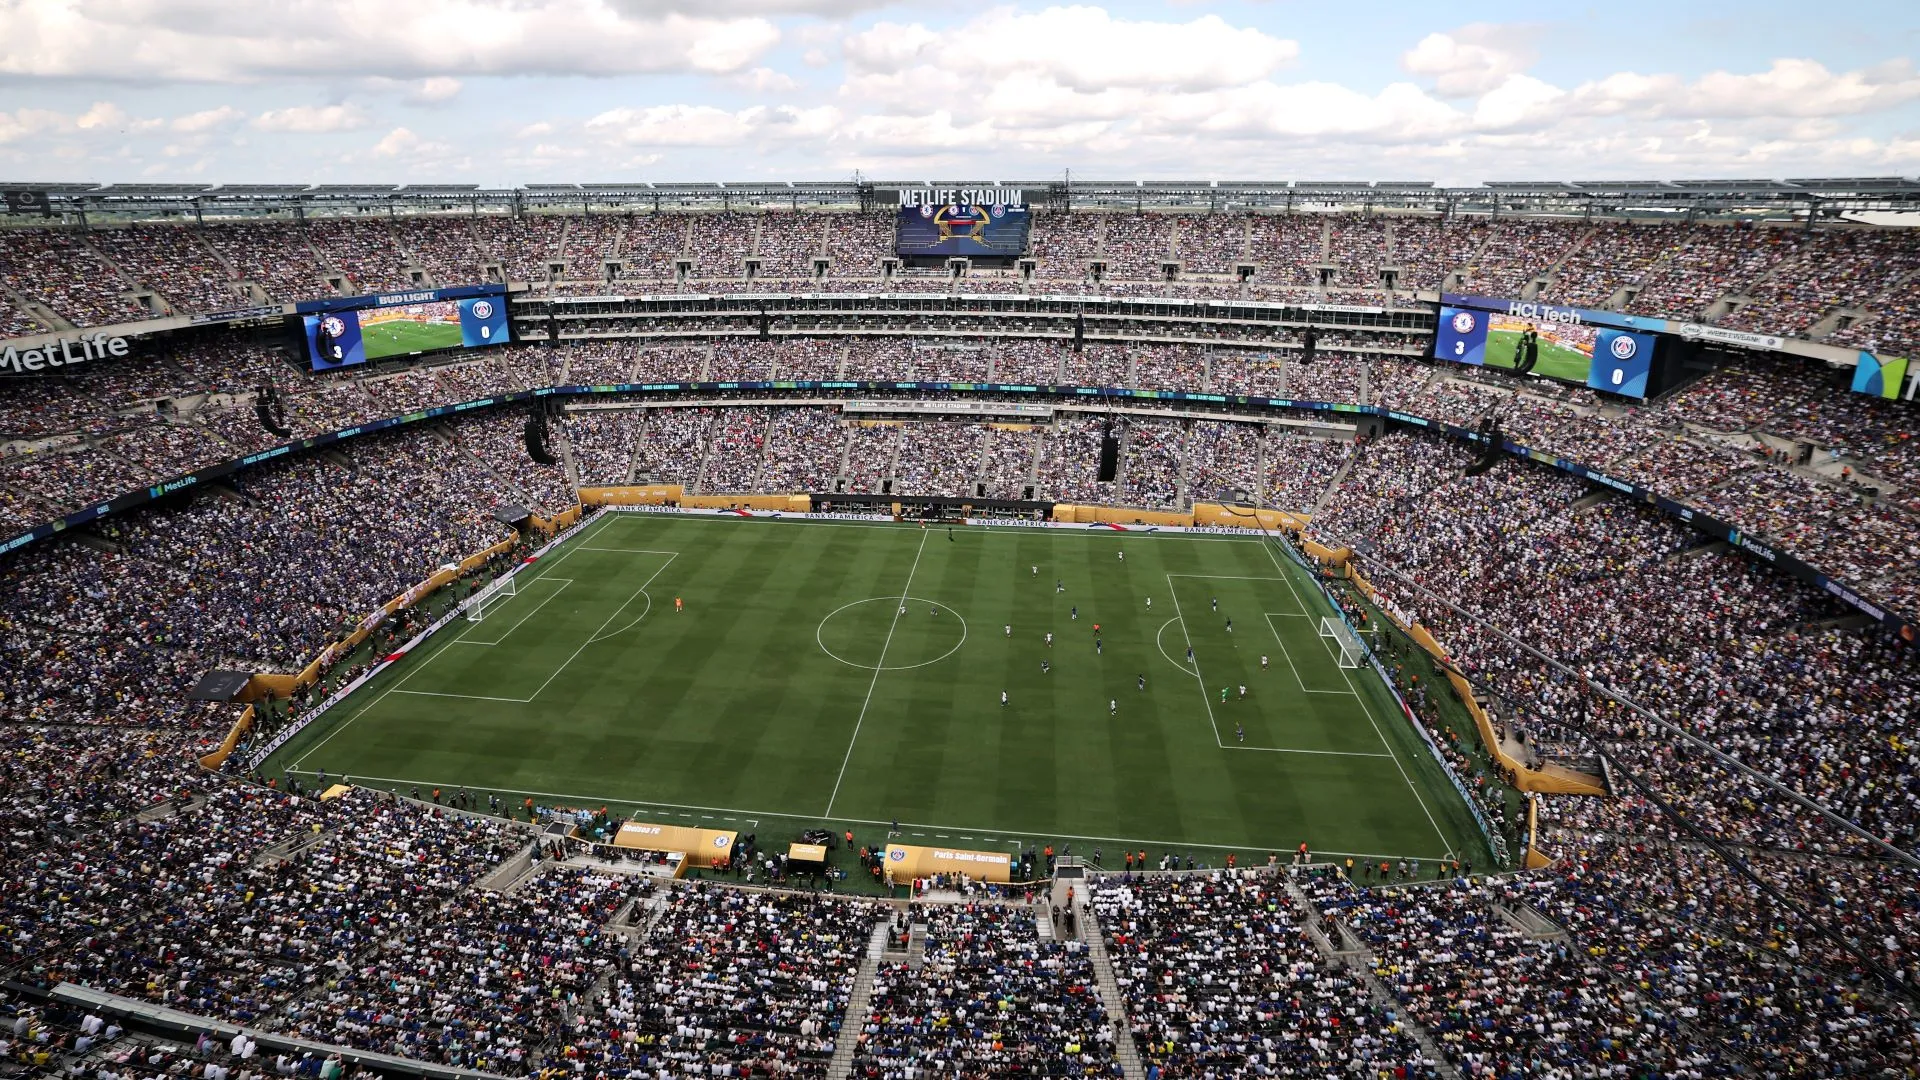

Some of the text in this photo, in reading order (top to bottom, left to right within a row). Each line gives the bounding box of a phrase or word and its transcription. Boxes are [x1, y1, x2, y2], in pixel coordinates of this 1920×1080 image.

[899, 189, 1022, 206] METLIFE STADIUM
[379, 292, 435, 305] BUD LIGHT
[1509, 302, 1581, 324] HCLTech
[481, 326, 489, 338] 0
[0, 332, 129, 372] MetLife
[334, 345, 342, 359] 3
[1455, 341, 1464, 355] 3
[1612, 368, 1623, 384] 0
[164, 476, 197, 492] MetLife
[561, 530, 575, 541] BANK
[581, 510, 604, 529] AMERICA
[1742, 538, 1776, 562] MetLife
[439, 609, 458, 626] BANK
[251, 696, 338, 768] BANK OF AMERICA
[1439, 756, 1457, 782] BANK
[623, 824, 650, 834] Chelsea
[934, 851, 1007, 864] Paris Saint-Germain
